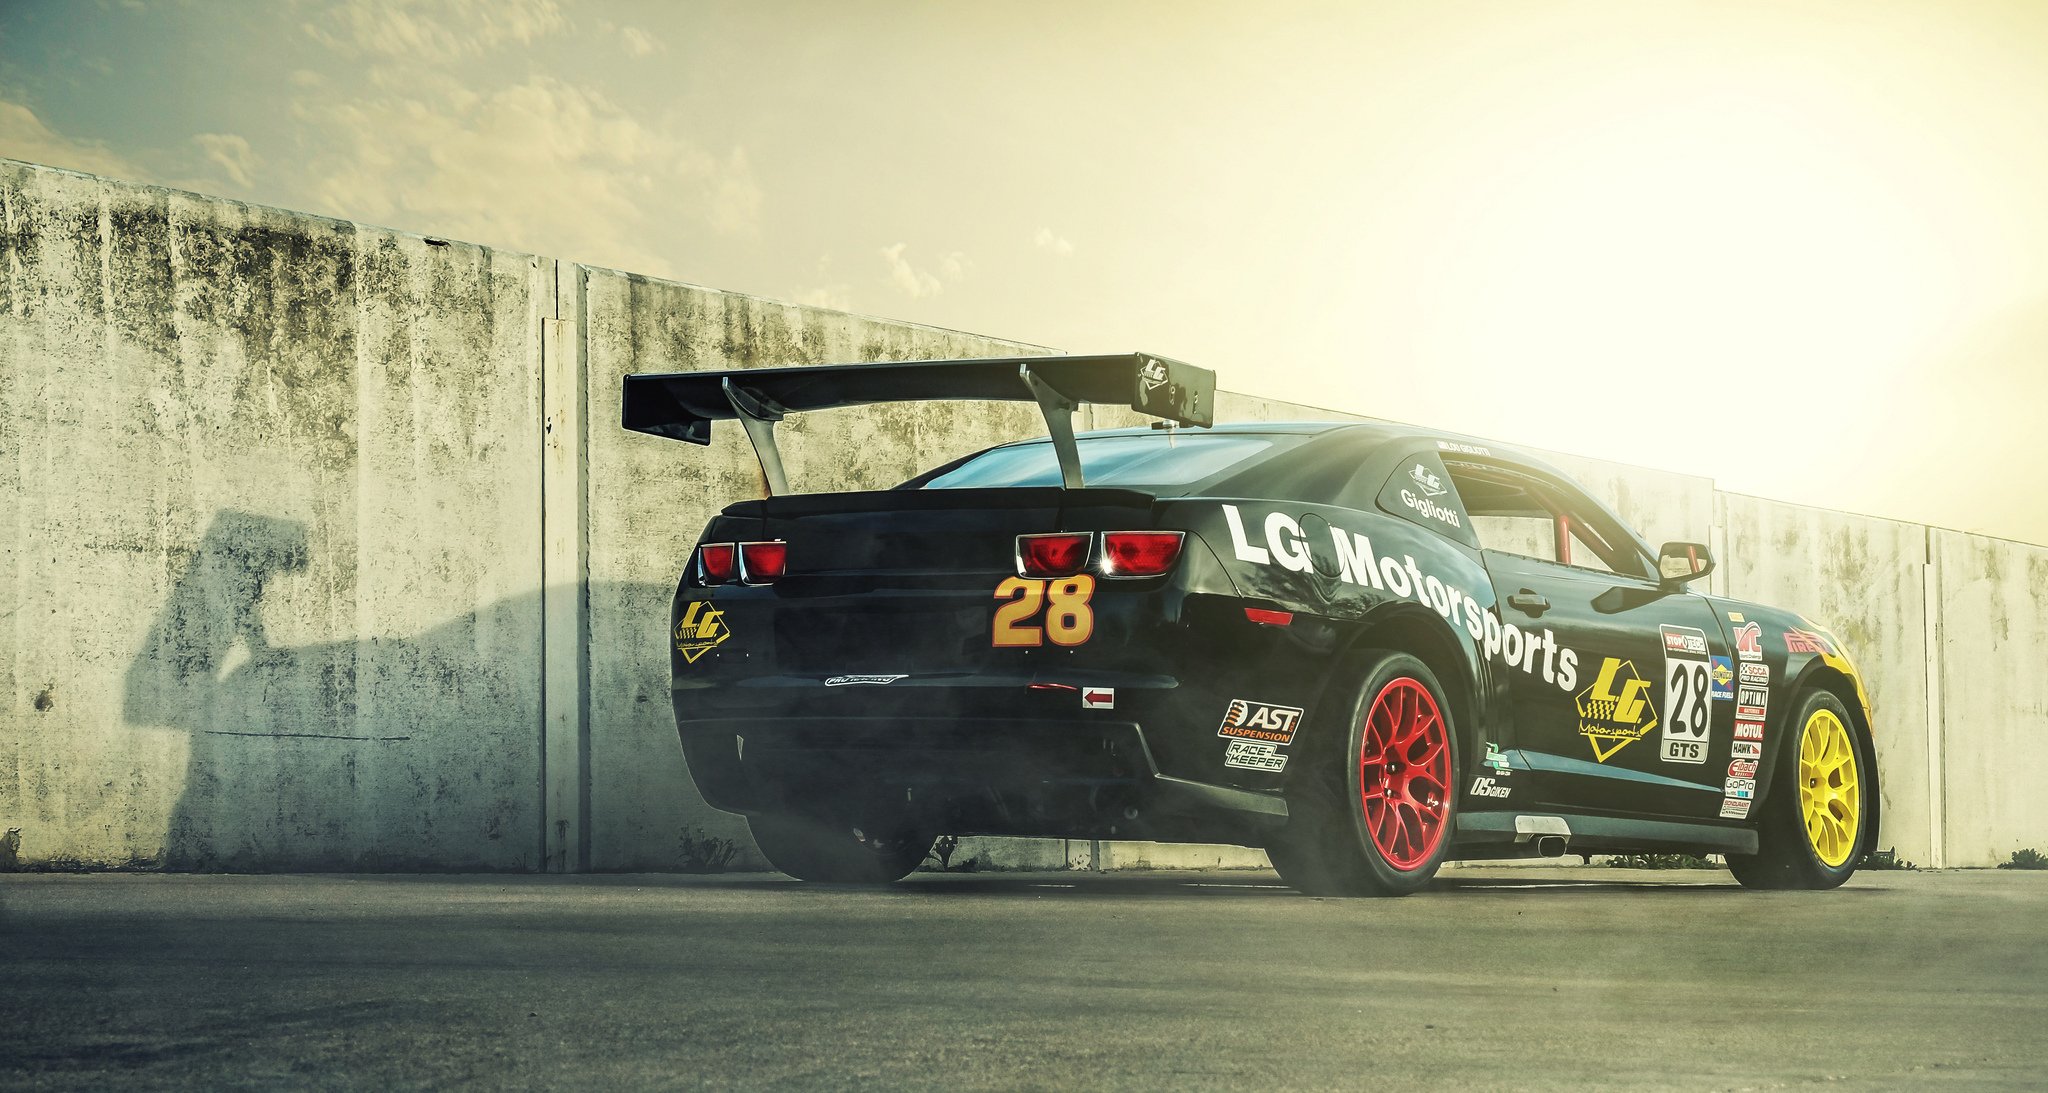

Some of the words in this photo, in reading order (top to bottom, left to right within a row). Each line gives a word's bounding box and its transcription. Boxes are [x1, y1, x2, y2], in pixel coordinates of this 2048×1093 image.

[1401, 489, 1460, 528] Gigliotti
[1222, 504, 1314, 574] LG
[1329, 525, 1579, 692] Motorsports
[992, 573, 1095, 647] 28
[1748, 666, 1767, 675] SCCA
[1670, 663, 1708, 738] 28
[1740, 690, 1765, 705] OPTIMA
[1246, 707, 1300, 731] AST
[1222, 726, 1290, 742] SUSPENSION
[1579, 720, 1641, 741] Motorsports
[1735, 723, 1762, 738] MOTUL
[1230, 744, 1272, 756] RACE-
[1669, 742, 1700, 758] GTS
[1733, 743, 1751, 754] HAWK
[1229, 754, 1283, 768] KEEPER
[1470, 777, 1496, 796] OS
[1490, 786, 1512, 798] GIKEN
[1726, 779, 1754, 790] GoPro
